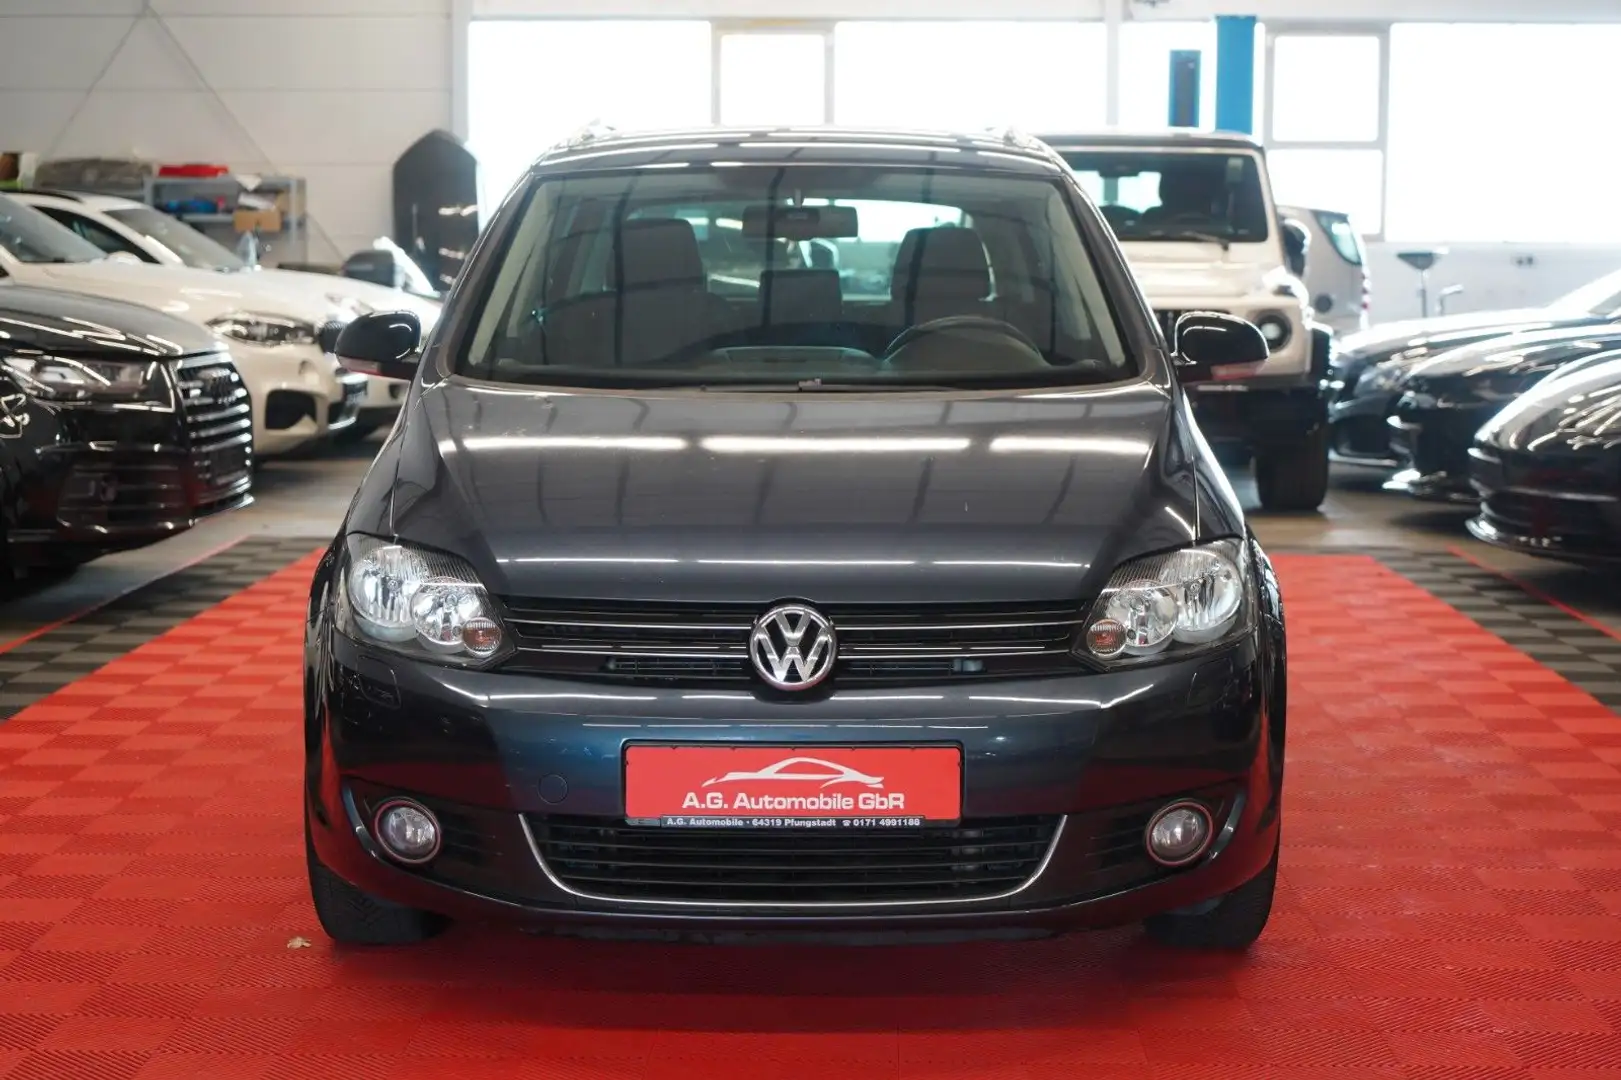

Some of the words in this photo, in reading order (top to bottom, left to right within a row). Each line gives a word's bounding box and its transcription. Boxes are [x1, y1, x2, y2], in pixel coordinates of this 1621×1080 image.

[681, 791, 729, 809] A.G.
[733, 792, 854, 810] Automobile
[858, 793, 905, 810] GbR
[666, 818, 687, 826] A.G.
[689, 818, 744, 827] Automobile
[751, 818, 782, 827] 64319
[784, 818, 837, 828] Pfungstadt
[853, 818, 876, 827] 0171
